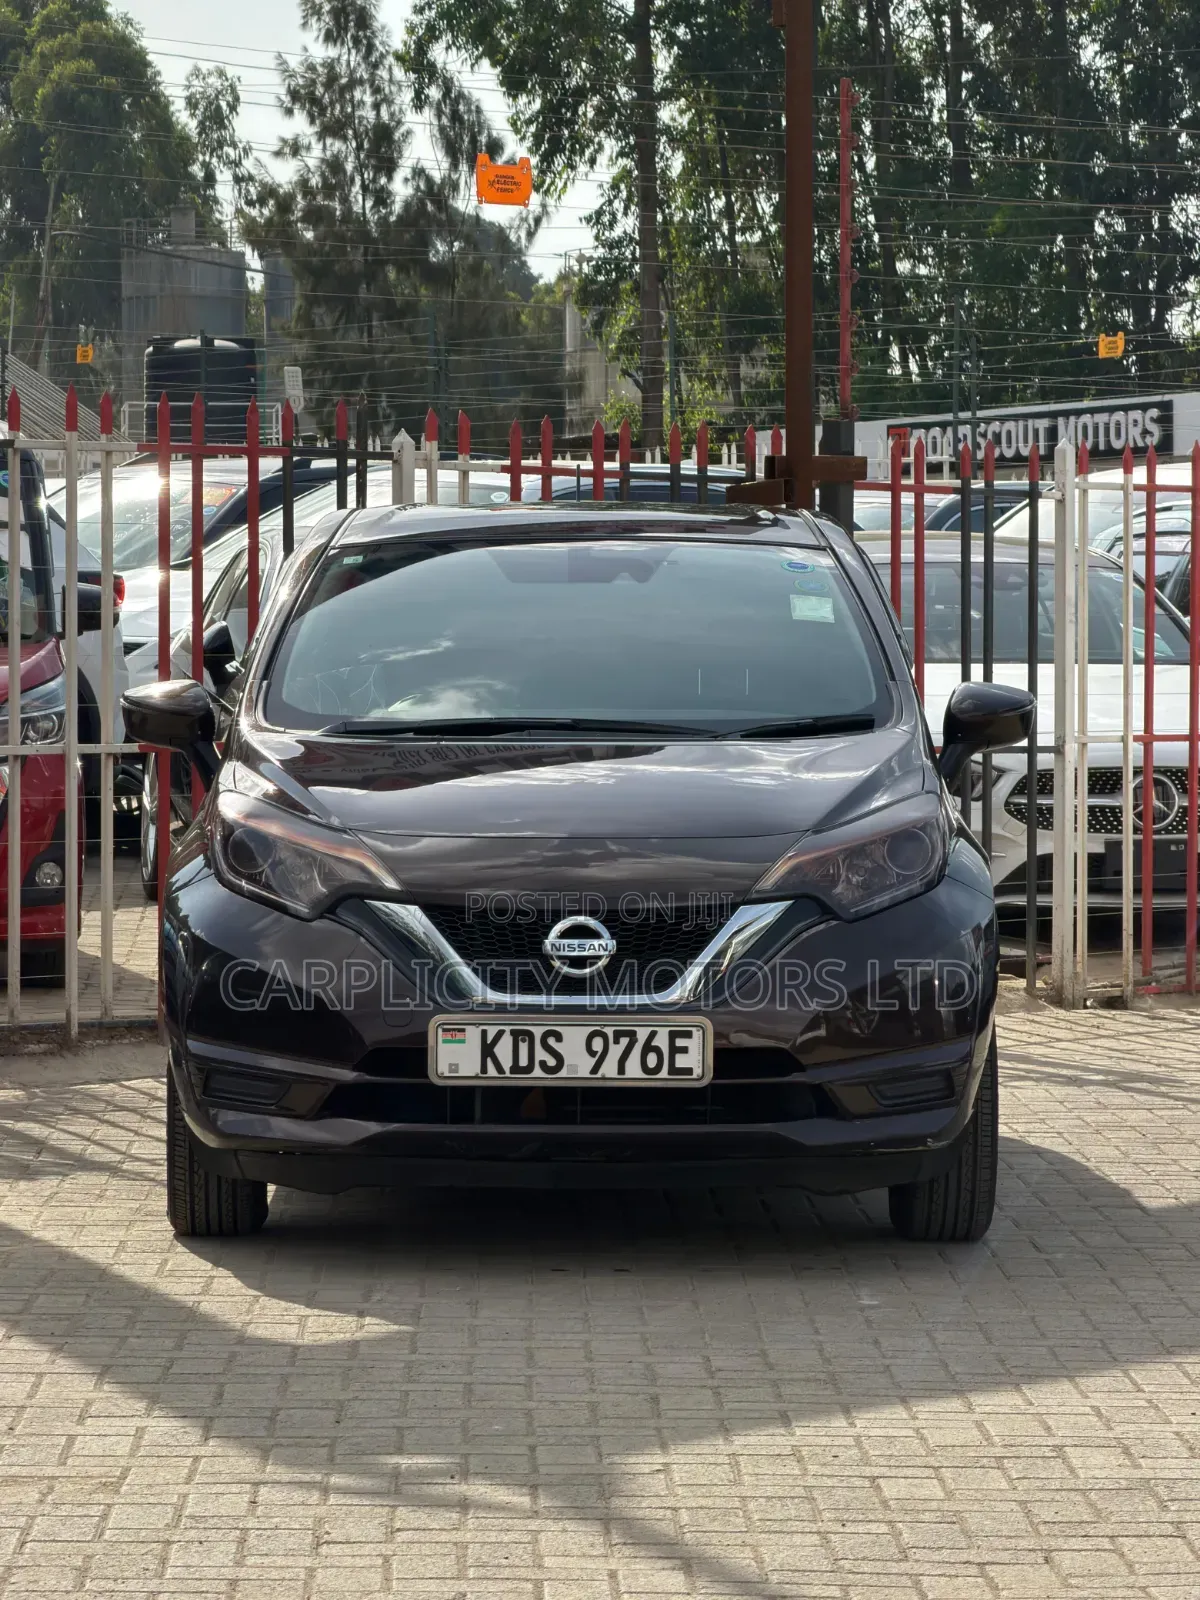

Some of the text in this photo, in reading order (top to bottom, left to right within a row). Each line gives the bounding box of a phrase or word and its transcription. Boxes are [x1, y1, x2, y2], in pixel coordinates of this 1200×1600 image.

[496, 179, 522, 187] ELECTRIC
[1057, 408, 1163, 454] MOTORS
[550, 943, 609, 952] NISSAN
[480, 1029, 565, 1076] KDS
[585, 1029, 694, 1076] 976E
